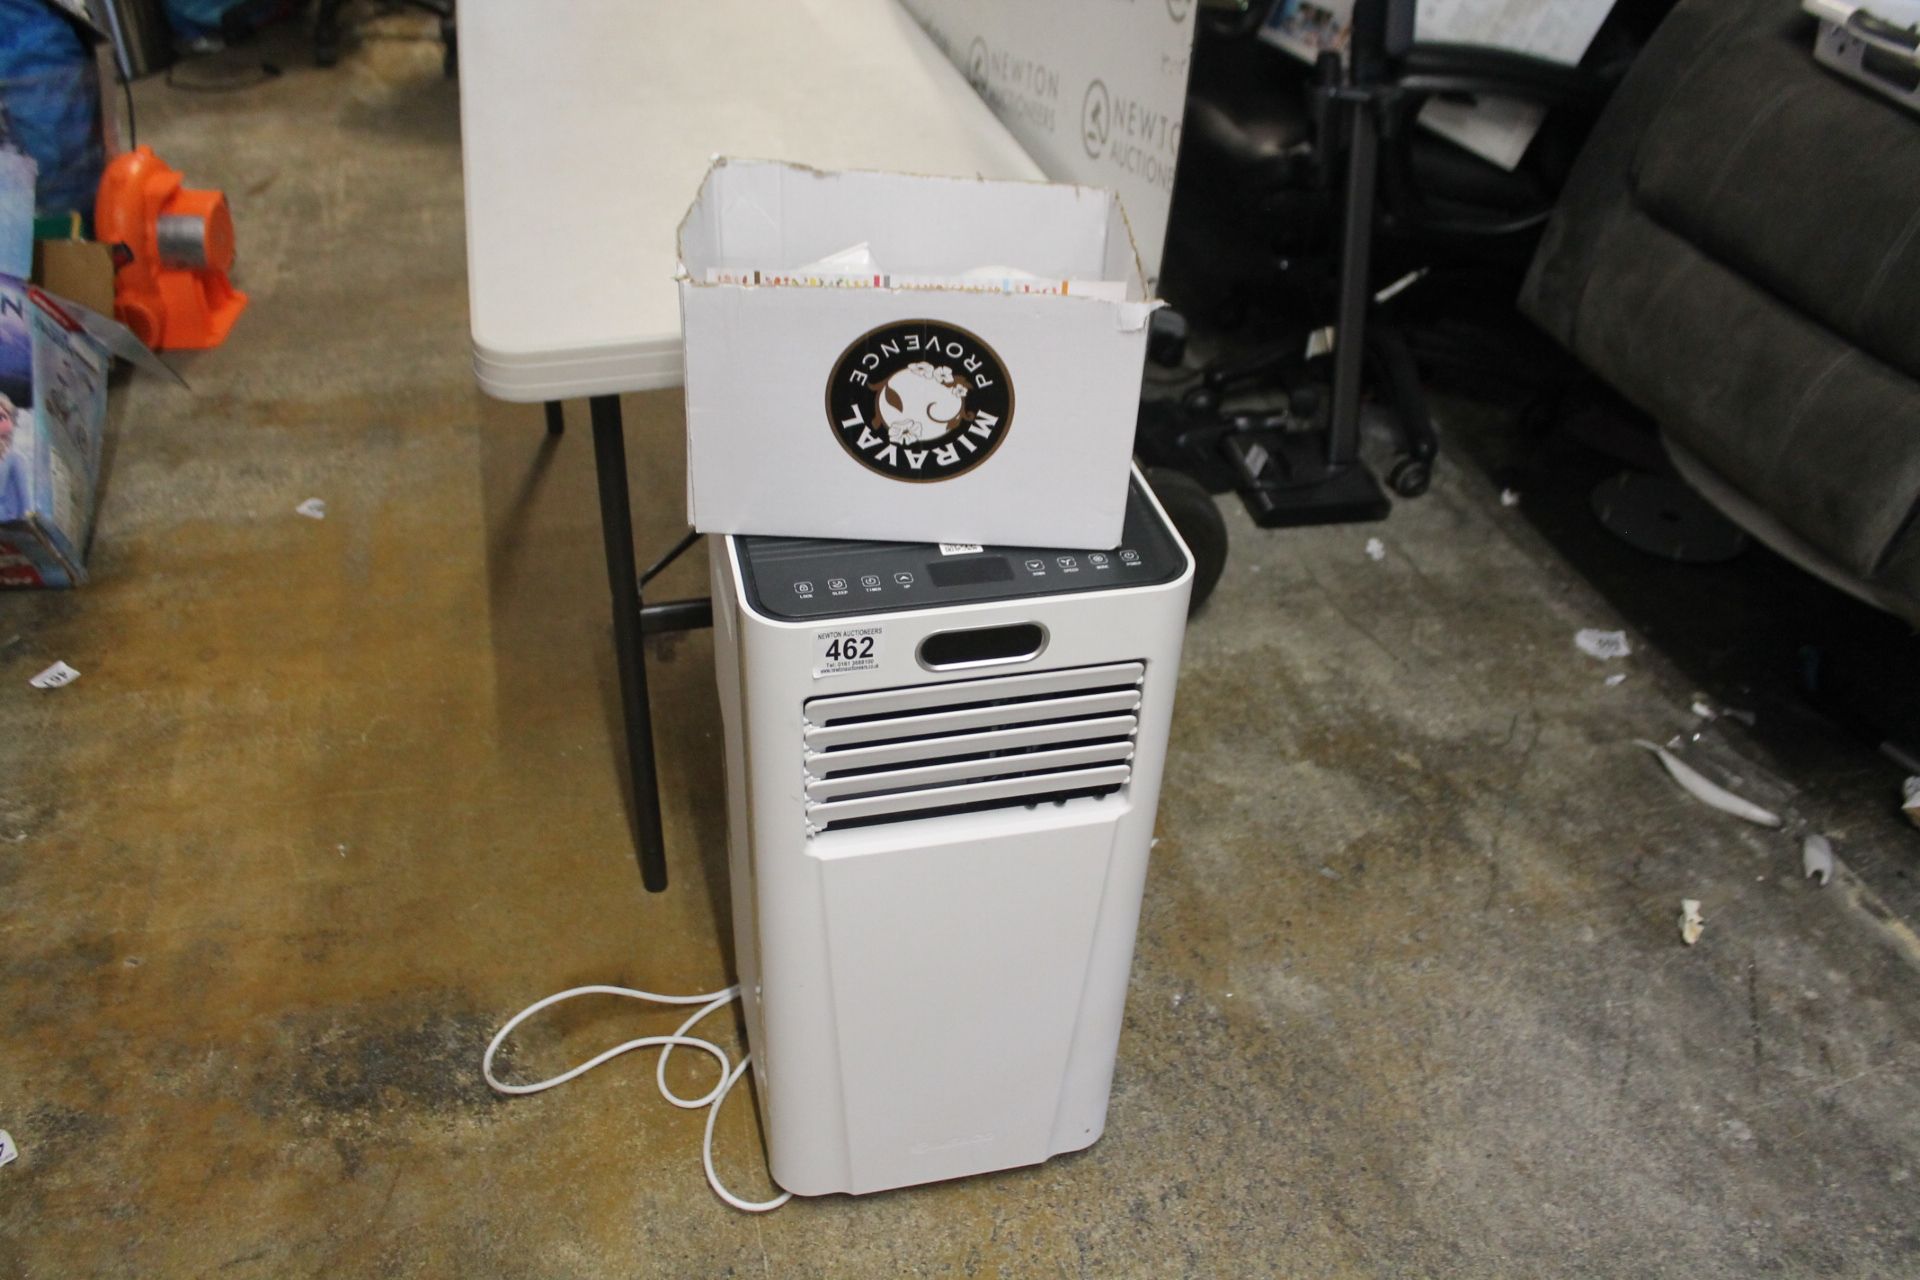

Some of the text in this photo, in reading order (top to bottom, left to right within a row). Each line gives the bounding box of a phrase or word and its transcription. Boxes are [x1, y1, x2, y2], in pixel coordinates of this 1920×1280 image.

[991, 51, 1060, 99] NEWTON
[1113, 97, 1182, 157] NEWTO
[849, 334, 993, 389] PROVENCE
[841, 403, 999, 470] MIRAVAL
[817, 628, 882, 640] NEWTON AUCTIONEERS
[825, 636, 874, 661] 462
